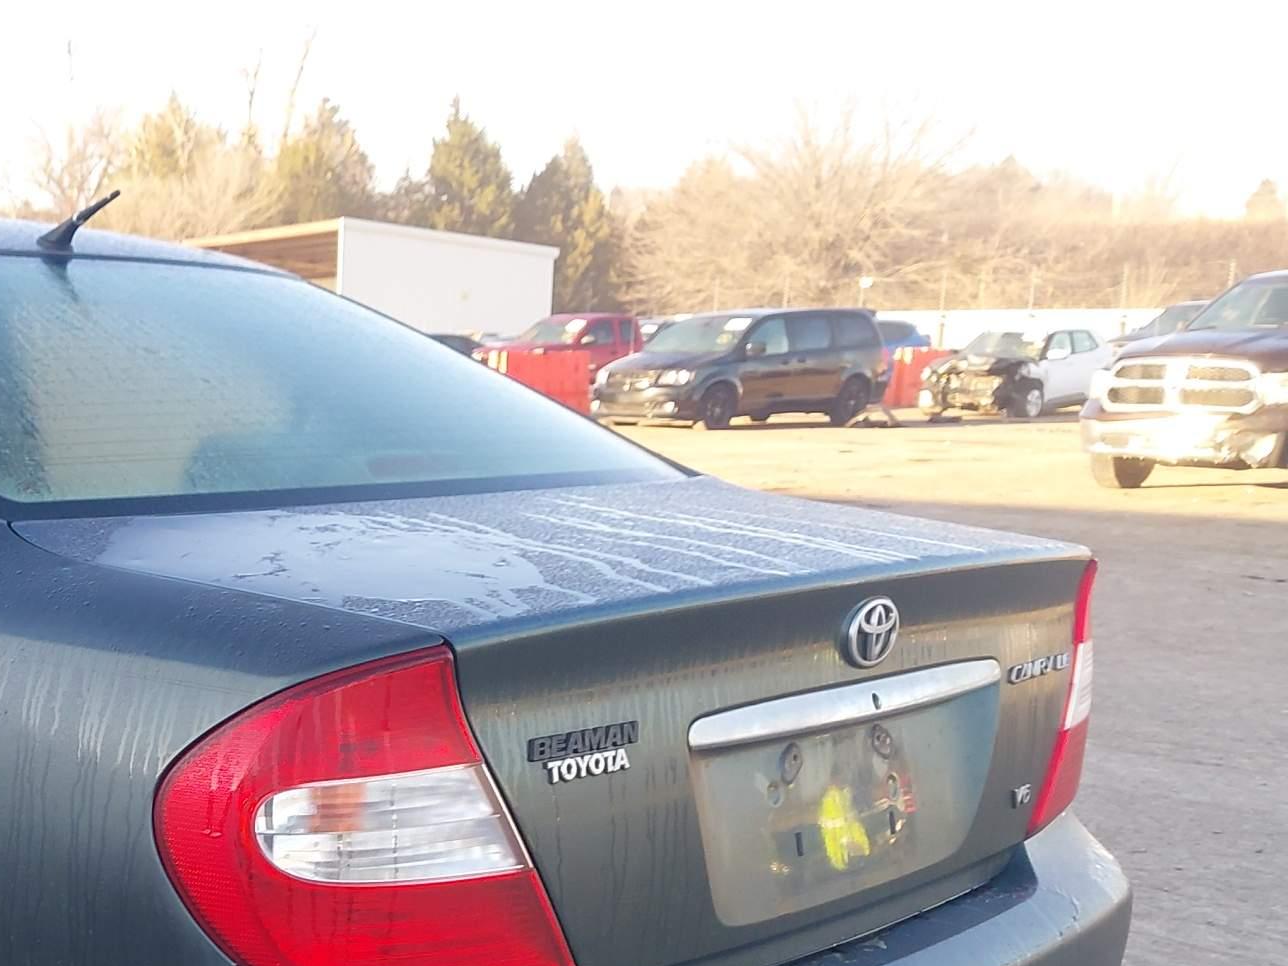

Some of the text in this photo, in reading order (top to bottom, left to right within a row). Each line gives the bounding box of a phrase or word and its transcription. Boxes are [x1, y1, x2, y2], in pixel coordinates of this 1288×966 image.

[530, 721, 639, 761] BEAMAN
[545, 747, 631, 784] TOYOTA
[1013, 783, 1032, 807] V6
